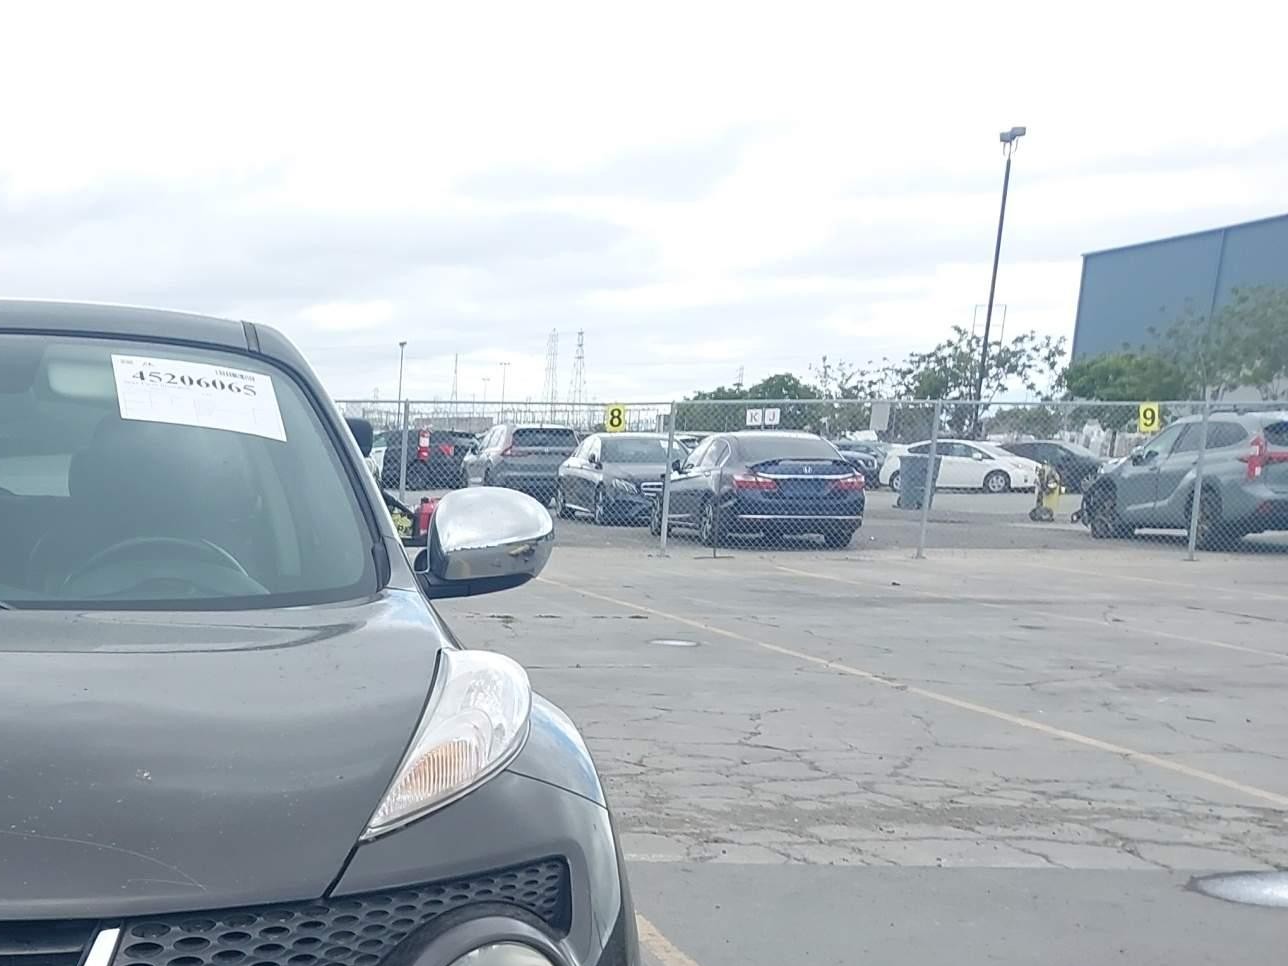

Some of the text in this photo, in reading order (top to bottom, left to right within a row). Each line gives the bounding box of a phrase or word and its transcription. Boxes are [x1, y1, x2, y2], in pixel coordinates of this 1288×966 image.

[132, 370, 257, 398] 45206065
[609, 407, 623, 428] 8
[1142, 407, 1156, 428] 9
